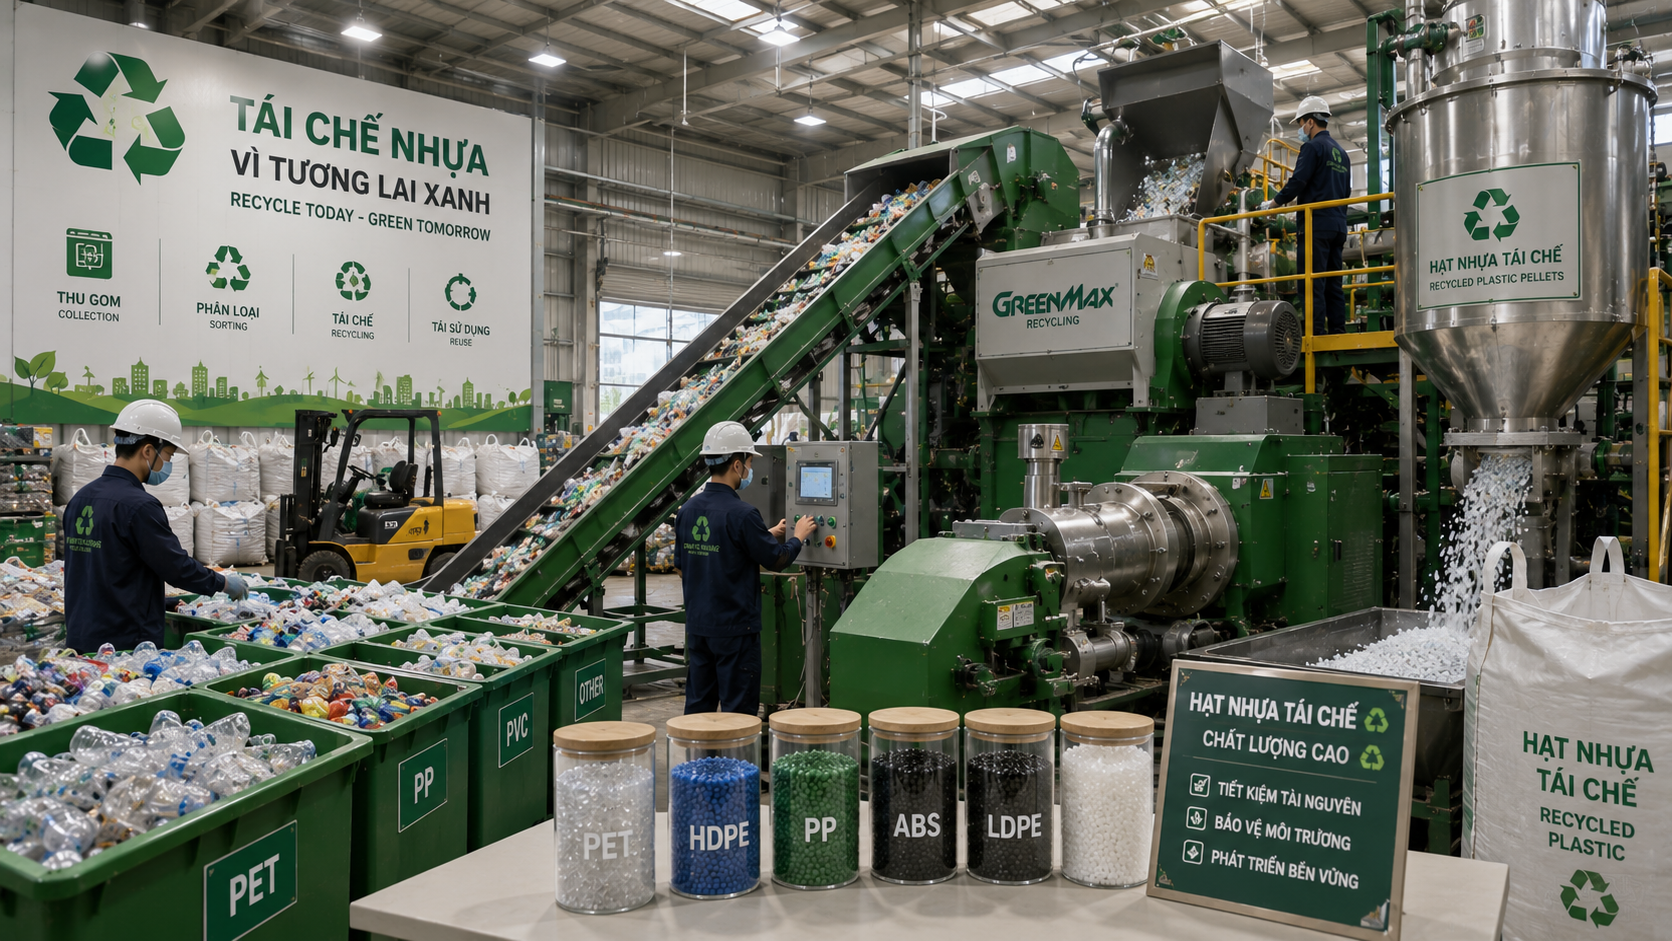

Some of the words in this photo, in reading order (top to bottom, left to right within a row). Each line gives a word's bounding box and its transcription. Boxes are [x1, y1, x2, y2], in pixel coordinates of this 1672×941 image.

[230, 94, 292, 140] TÁI
[306, 112, 383, 156] CHẾ
[392, 127, 489, 178] NHỰA
[230, 146, 259, 178] VÌ
[269, 155, 369, 195] TƯƠNG
[379, 174, 416, 202] LAI
[424, 182, 490, 214] XANH
[230, 192, 301, 215] RECYCLE
[306, 202, 354, 222] TODAY
[368, 212, 412, 231] GREEN
[416, 219, 491, 242] TOMORROW
[1430, 258, 1454, 275] HẠT
[1458, 252, 1498, 272] NHỰA
[1502, 248, 1526, 266] TÁI
[1530, 244, 1564, 264] CHẾ
[1430, 278, 1474, 291] RECYCLED
[1476, 274, 1518, 286] PLASTIC
[1520, 271, 1564, 282] PELLETS
[57, 291, 85, 304] THU
[89, 293, 121, 308] GOM
[196, 301, 230, 316] PHÂN
[234, 305, 260, 320] LOẠI
[58, 309, 120, 322] COLLECTION
[210, 320, 248, 331] SORTING
[1026, 316, 1080, 329] RECYCLING
[332, 329, 375, 340] RECYCLING
[450, 337, 472, 347] REUSE
[464, 324, 490, 338] DỤNG
[579, 674, 604, 704] OTHER
[1189, 691, 1225, 717] HẠT
[1228, 696, 1280, 724] NHỰA
[1284, 698, 1312, 724] TÁI
[1317, 702, 1360, 730] CHẾ
[506, 712, 528, 747] PVC
[1203, 728, 1245, 750] CHẤT
[1249, 735, 1306, 760] LƯỢNG
[1312, 742, 1350, 765] CAO
[1523, 730, 1568, 762] HẠT
[1576, 740, 1654, 775] NHỰA
[414, 766, 434, 804] PP
[1218, 779, 1244, 798] TIẾT
[1246, 784, 1278, 805] KIỆM
[1281, 788, 1302, 806] TÀI
[1304, 794, 1362, 817] NGUYÊN
[1536, 767, 1574, 797] TÁI
[1582, 777, 1640, 808] CHẾ
[688, 820, 750, 852] HDPE
[804, 816, 836, 843] PP
[893, 812, 941, 838] ABS
[986, 812, 1042, 839] LDPE
[1245, 818, 1262, 838] VỆ
[1265, 822, 1291, 840] MÔI
[1540, 806, 1636, 839] RECYCLED
[583, 829, 634, 860] PET
[1211, 850, 1245, 869] PHÁT
[1548, 832, 1626, 861] PLASTIC
[229, 853, 280, 918] PET
